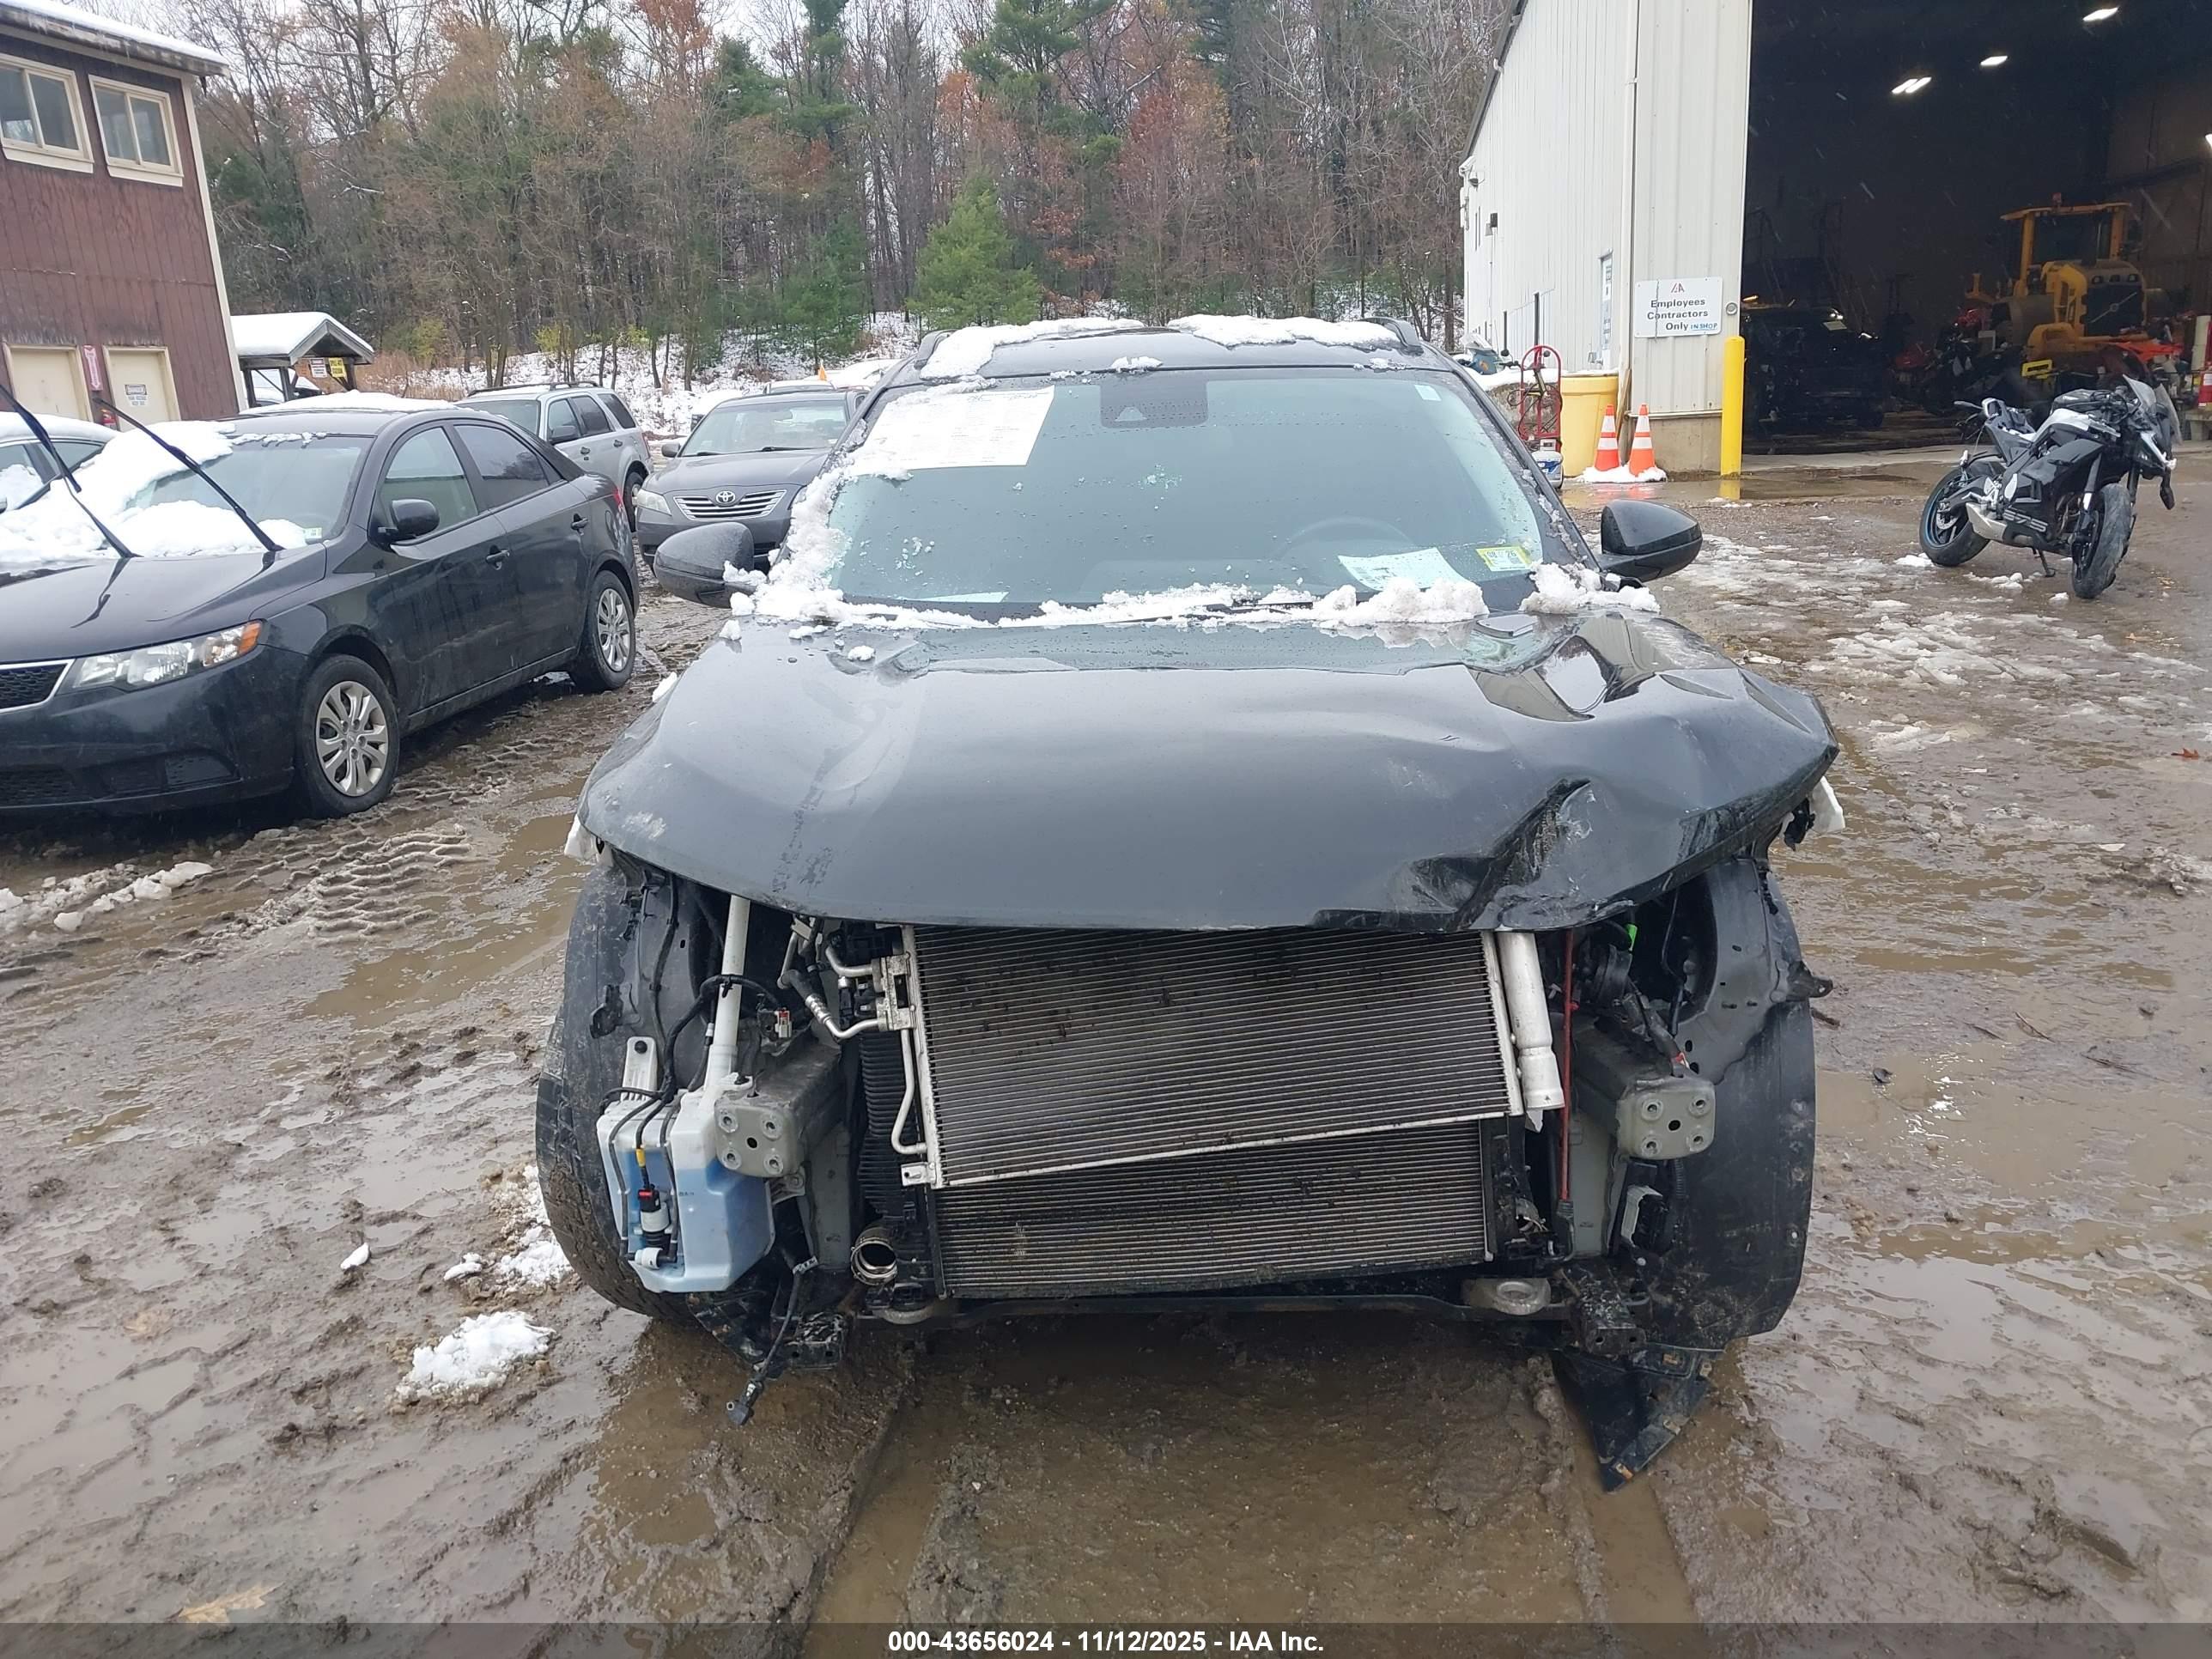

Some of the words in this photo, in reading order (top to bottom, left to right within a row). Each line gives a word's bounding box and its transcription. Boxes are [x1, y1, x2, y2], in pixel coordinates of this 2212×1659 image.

[1650, 299, 1705, 308] Employees
[1647, 310, 1709, 320] Contractors
[1665, 322, 1689, 331] Only
